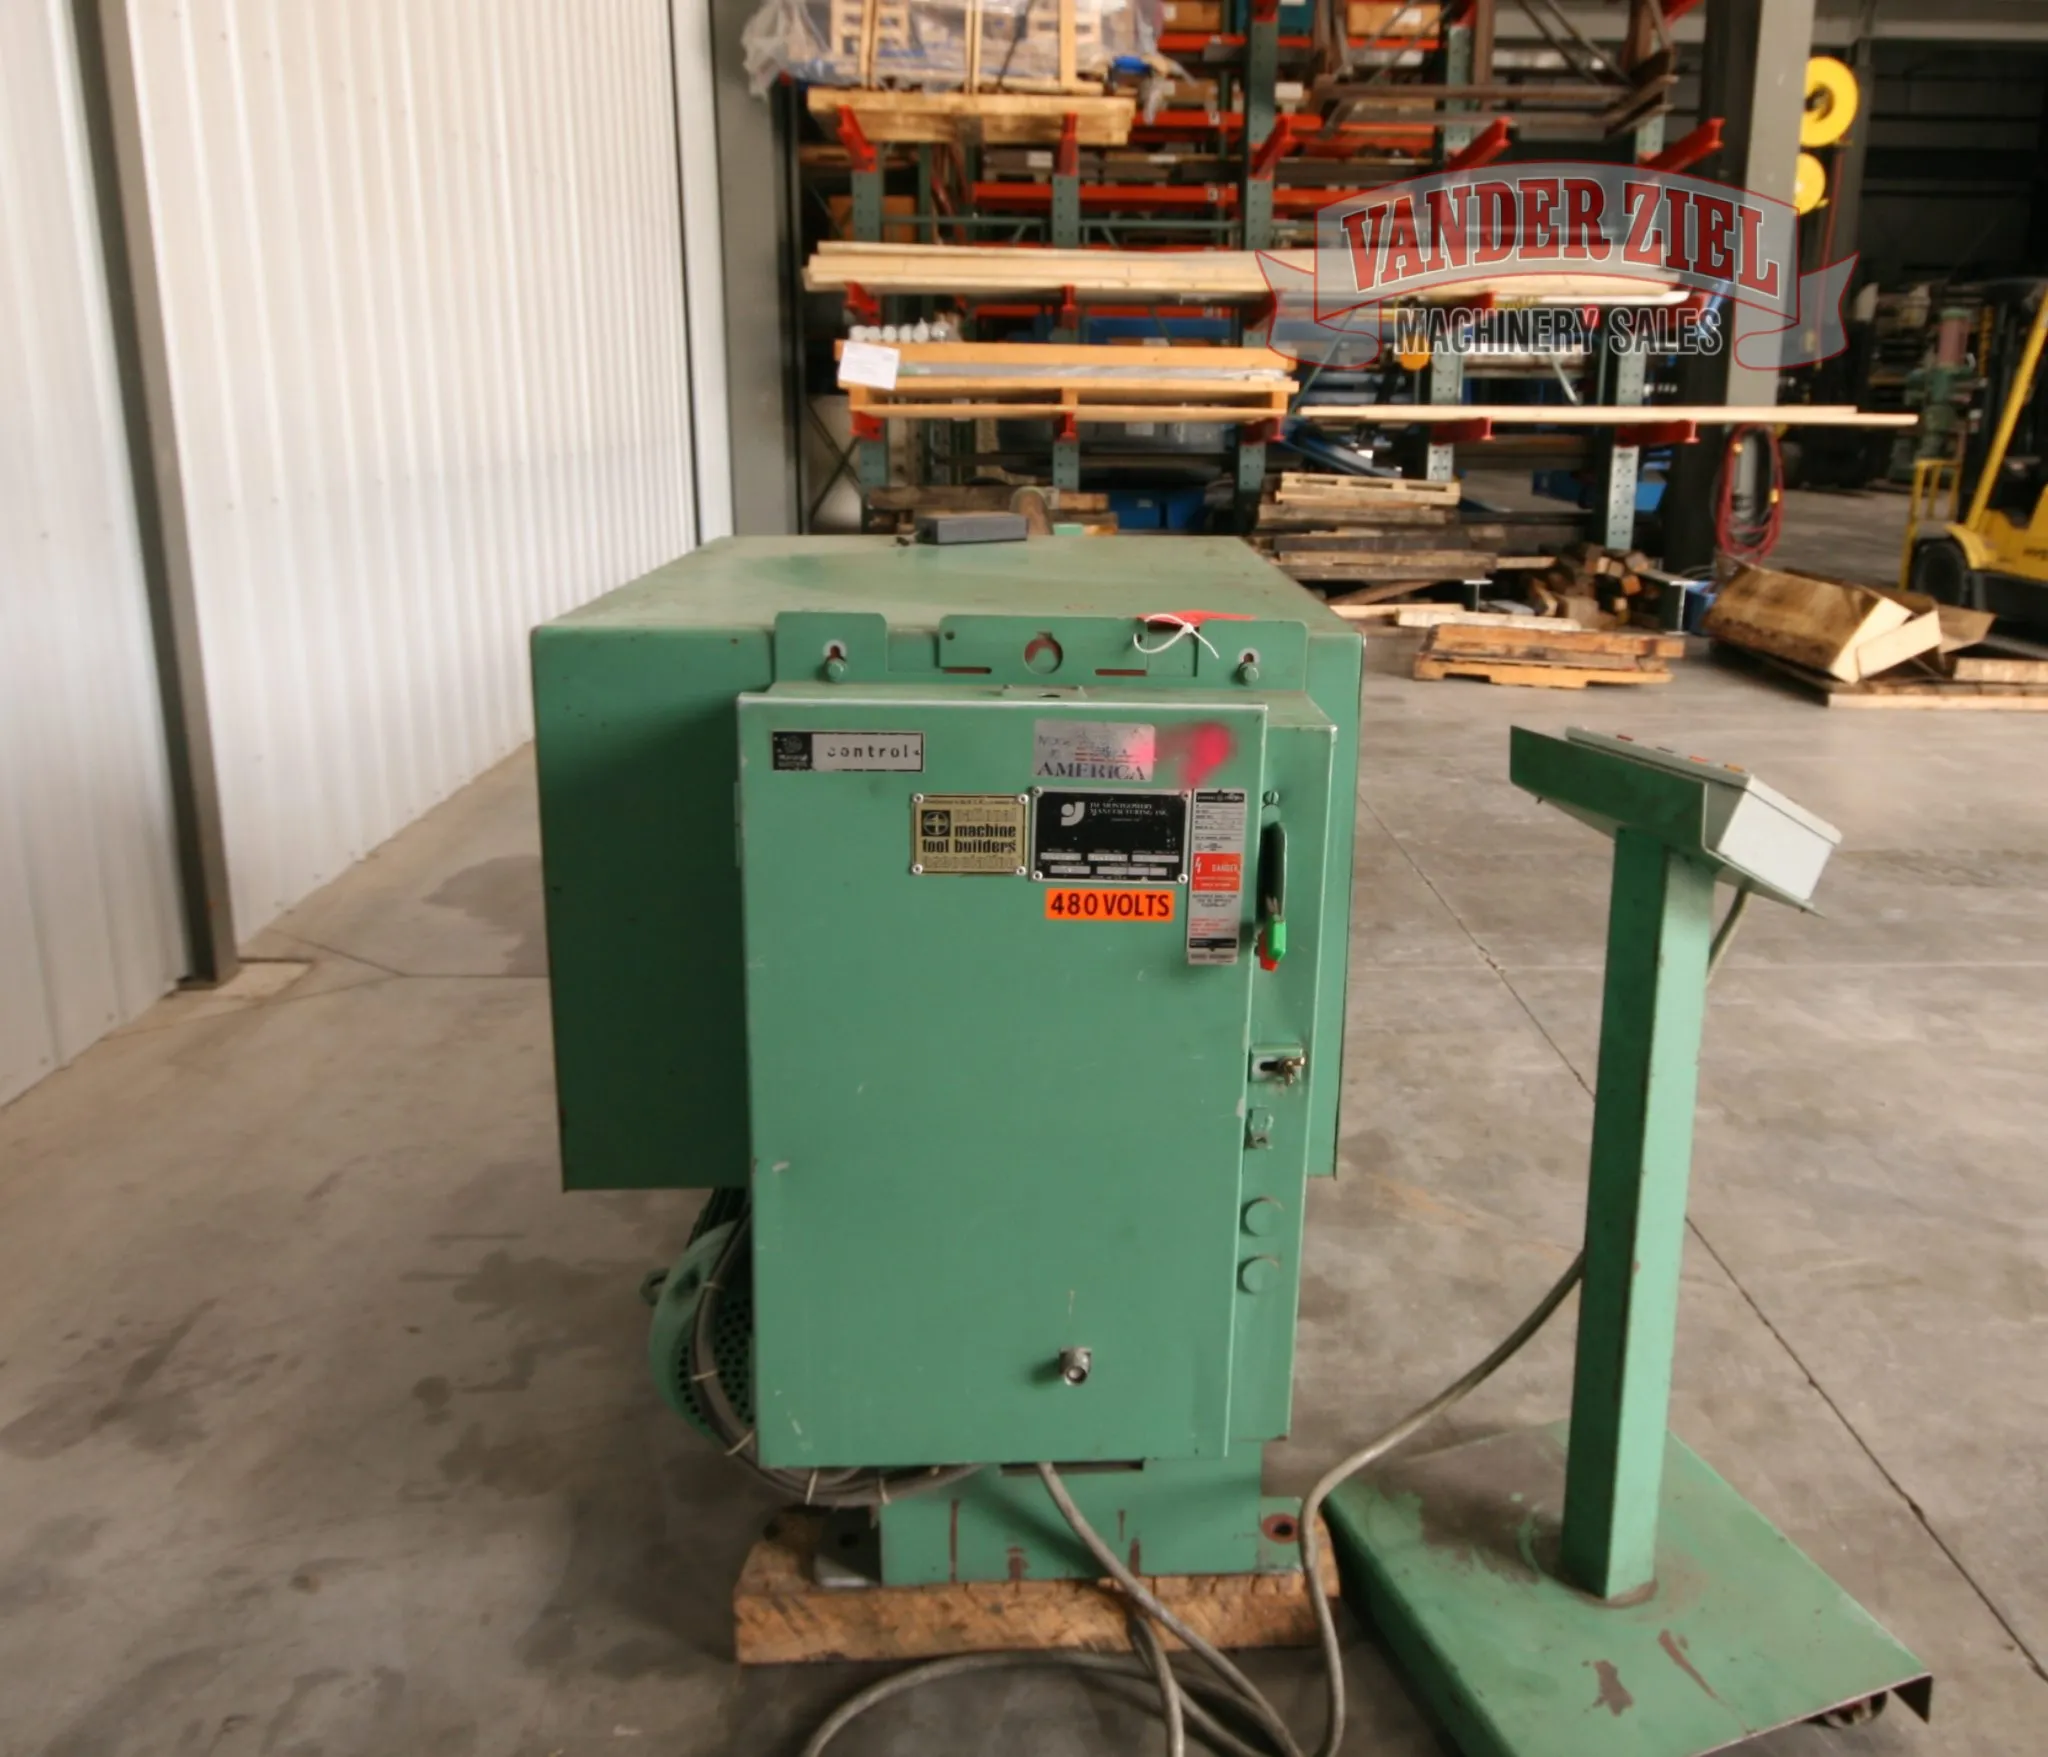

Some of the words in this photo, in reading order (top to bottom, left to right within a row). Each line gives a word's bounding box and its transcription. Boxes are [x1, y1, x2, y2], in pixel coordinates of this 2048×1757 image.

[1037, 761, 1146, 781] AMERICA
[955, 823, 1016, 837] machine
[923, 840, 949, 853] tool
[954, 839, 1016, 853] builders
[1051, 893, 1098, 915] 480
[1103, 894, 1170, 917] VOLTS
